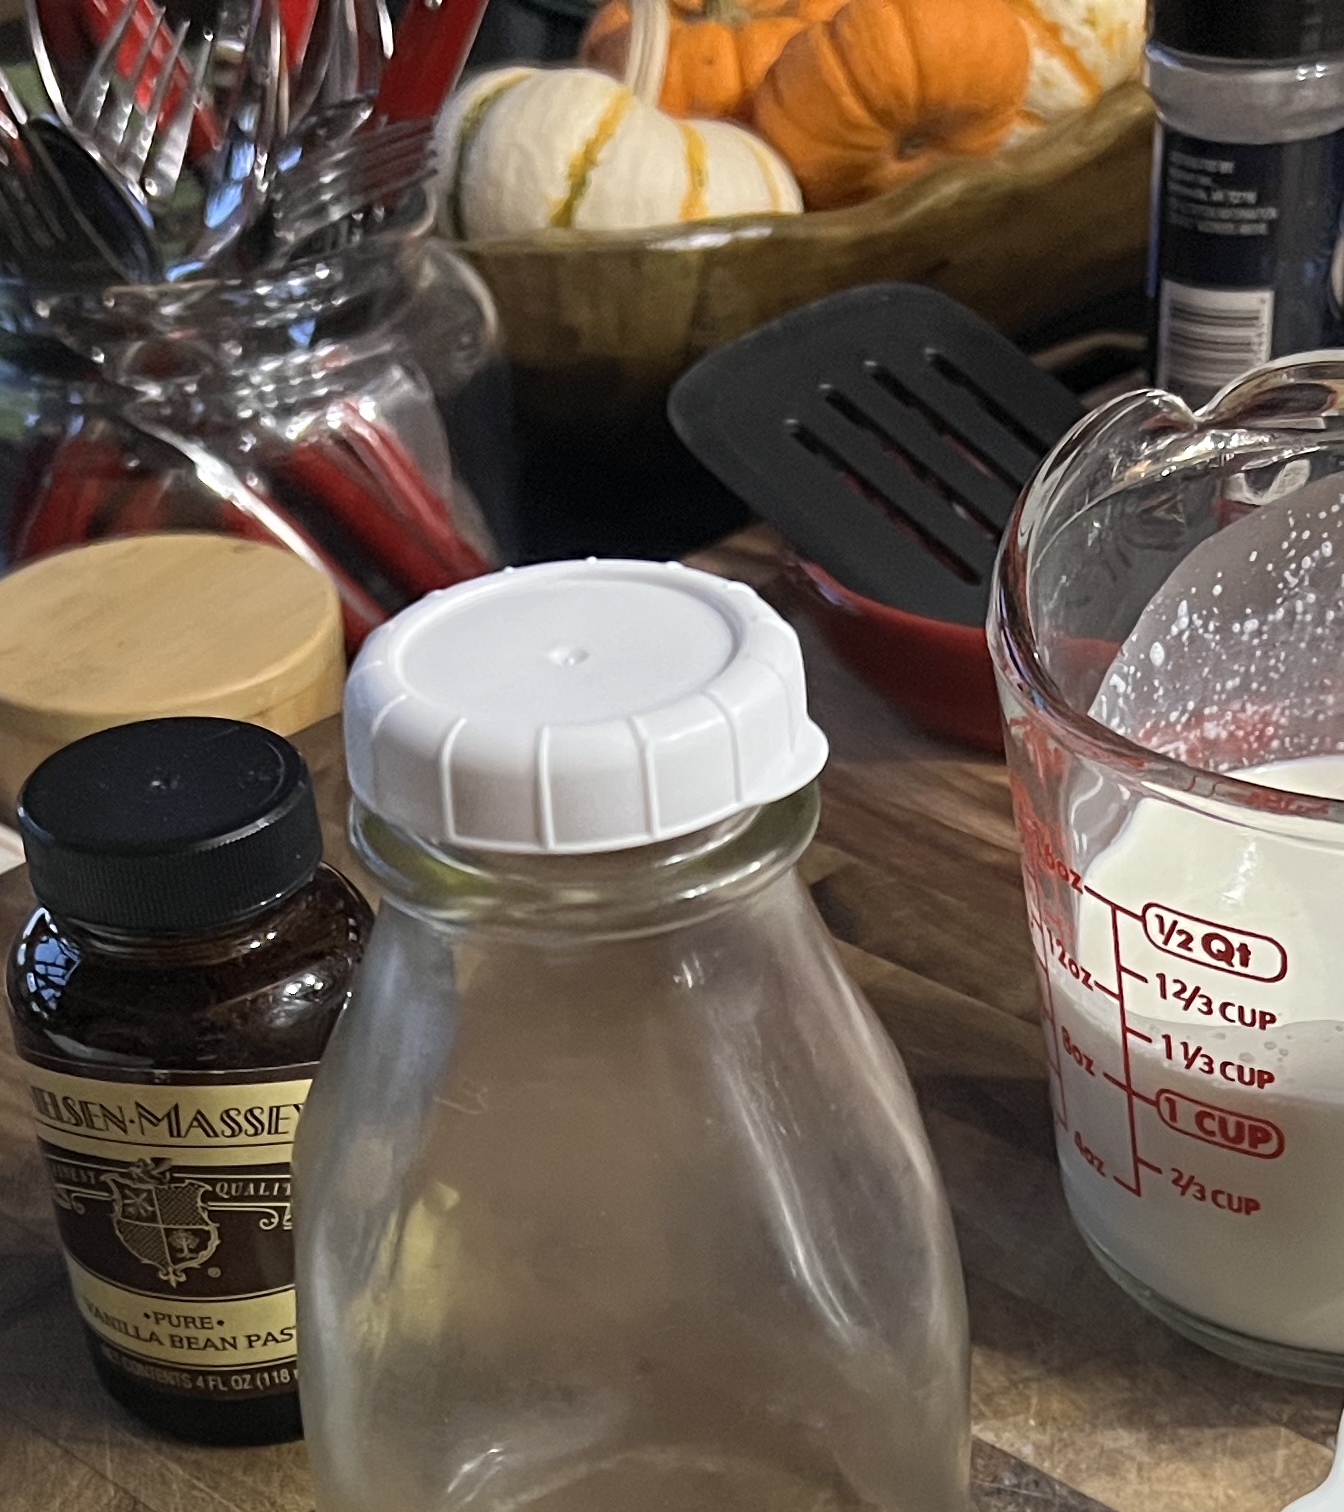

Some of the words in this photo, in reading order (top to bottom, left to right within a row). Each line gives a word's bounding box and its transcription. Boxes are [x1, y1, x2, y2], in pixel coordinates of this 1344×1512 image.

[1046, 926, 1094, 991] 12oz
[1155, 914, 1194, 952] 1/2
[1201, 932, 1252, 969] Qt
[1219, 1002, 1278, 1031] CUP
[1061, 1026, 1096, 1077] 8oz
[1220, 1061, 1276, 1089] CUP
[1164, 1096, 1177, 1123] 1
[1194, 1110, 1273, 1149] CUP
[215, 1181, 291, 1199] QUALIT
[1171, 1168, 1206, 1201] 2/3
[1211, 1189, 1261, 1215] CUP
[170, 1333, 238, 1351] BEAN
[244, 1325, 296, 1348] PAS
[197, 1375, 205, 1389] 4
[209, 1375, 227, 1390] FL
[231, 1373, 253, 1389] OZ
[256, 1369, 290, 1391] (118
